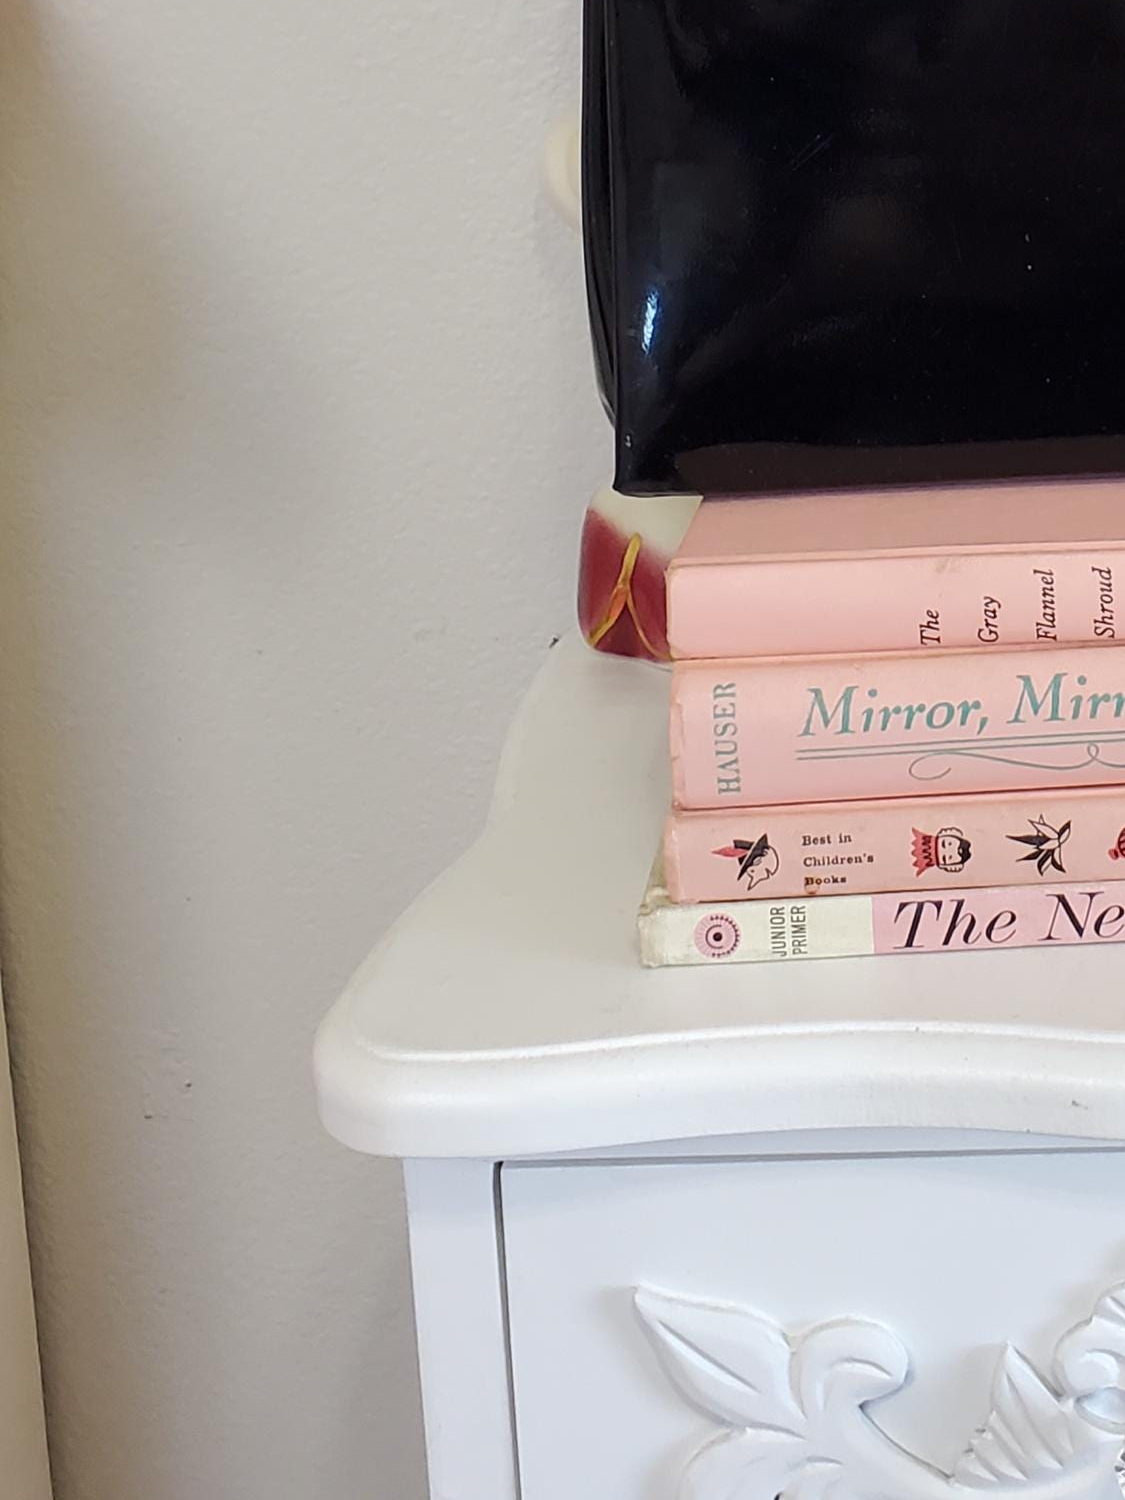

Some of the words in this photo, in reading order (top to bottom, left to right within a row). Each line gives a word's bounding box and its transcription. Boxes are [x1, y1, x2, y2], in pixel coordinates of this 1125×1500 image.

[919, 608, 943, 646] The
[977, 595, 1003, 643] Gray
[1035, 568, 1059, 642] Flannel
[1091, 566, 1115, 639] Shroud
[797, 684, 990, 737] Mirror,
[712, 681, 742, 795] HAUSER
[801, 833, 832, 847] Best
[838, 832, 853, 844] in
[802, 852, 874, 867] Children's
[804, 874, 847, 886] Books
[769, 905, 788, 957] JUNIOR
[791, 904, 809, 955] PRIMER
[892, 900, 1018, 950] The
